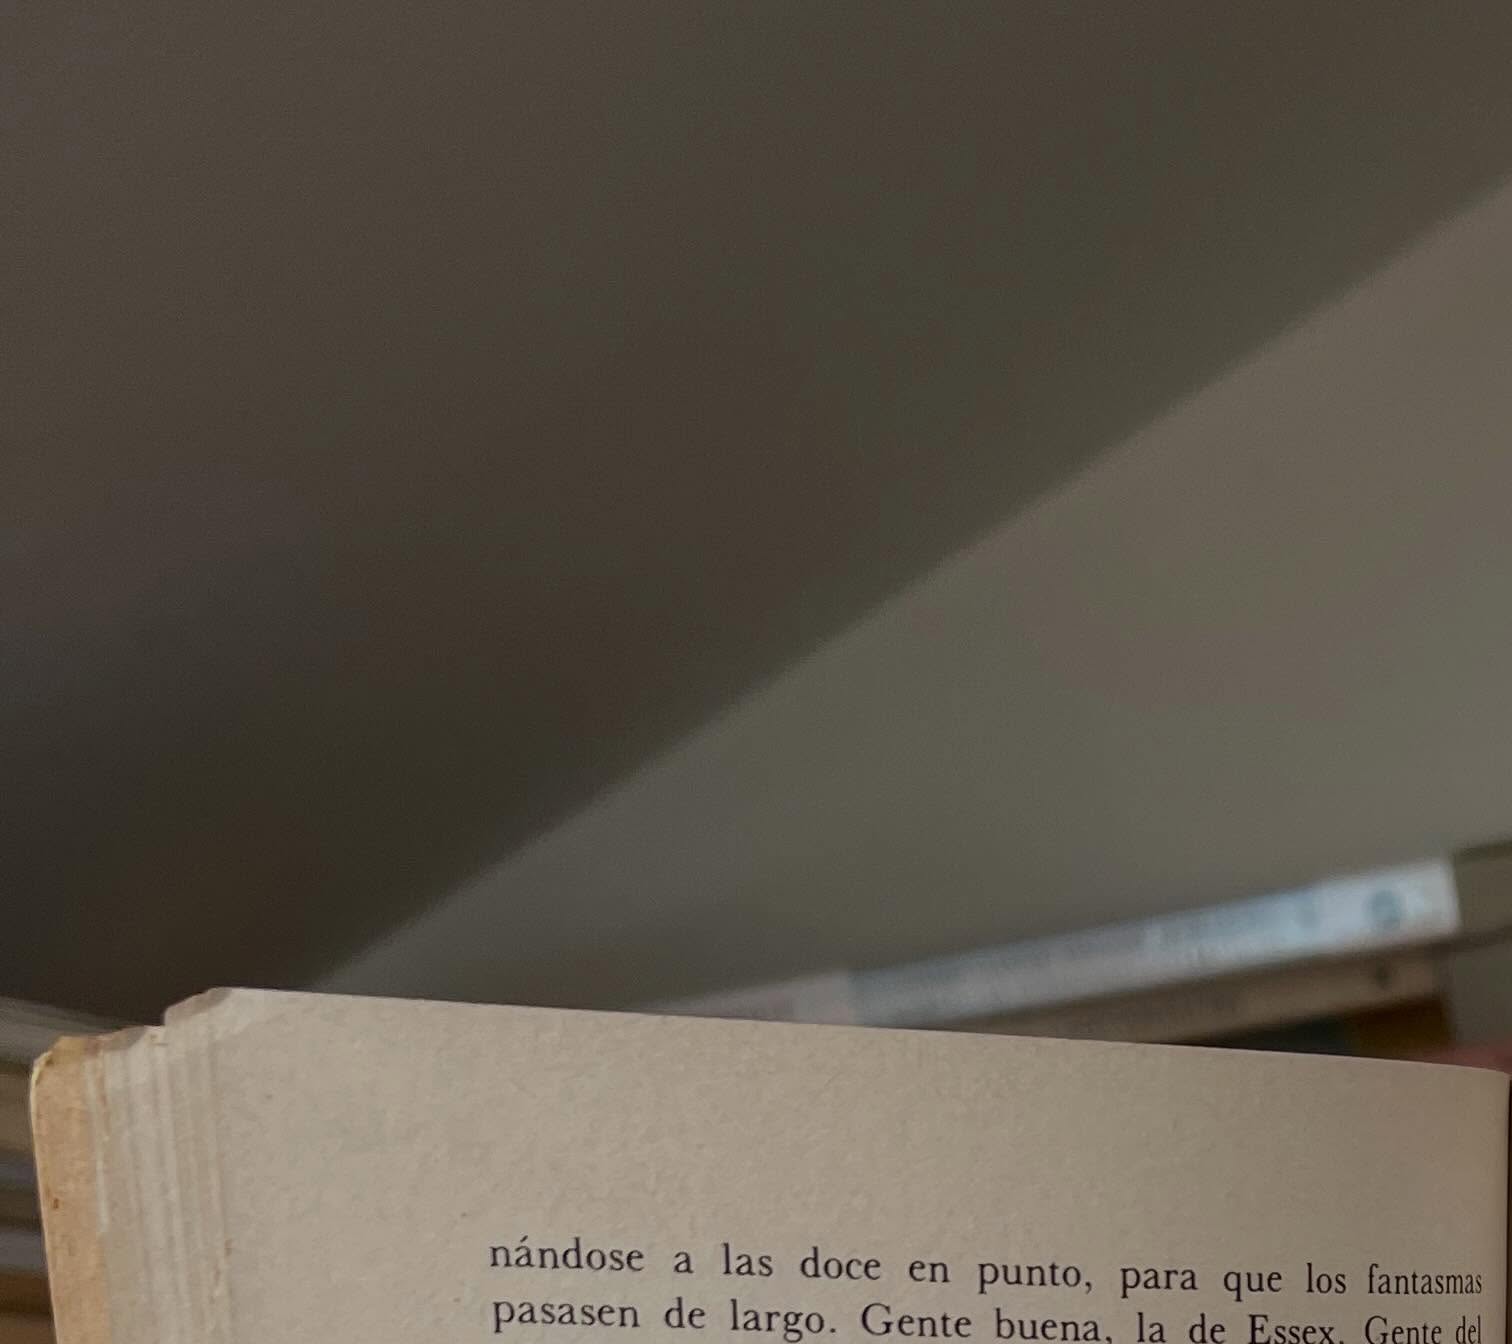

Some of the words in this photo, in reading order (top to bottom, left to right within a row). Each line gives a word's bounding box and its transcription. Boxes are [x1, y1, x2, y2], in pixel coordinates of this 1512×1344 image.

[489, 1234, 645, 1273] nándose
[673, 1251, 695, 1275] a
[721, 1241, 774, 1278] las
[799, 1245, 882, 1281] doce
[908, 1260, 951, 1284] en
[977, 1261, 1093, 1296] punto,
[1119, 1267, 1199, 1300] para
[1223, 1271, 1283, 1303] que
[1305, 1261, 1347, 1295] los
[1367, 1262, 1483, 1296] fantasmas
